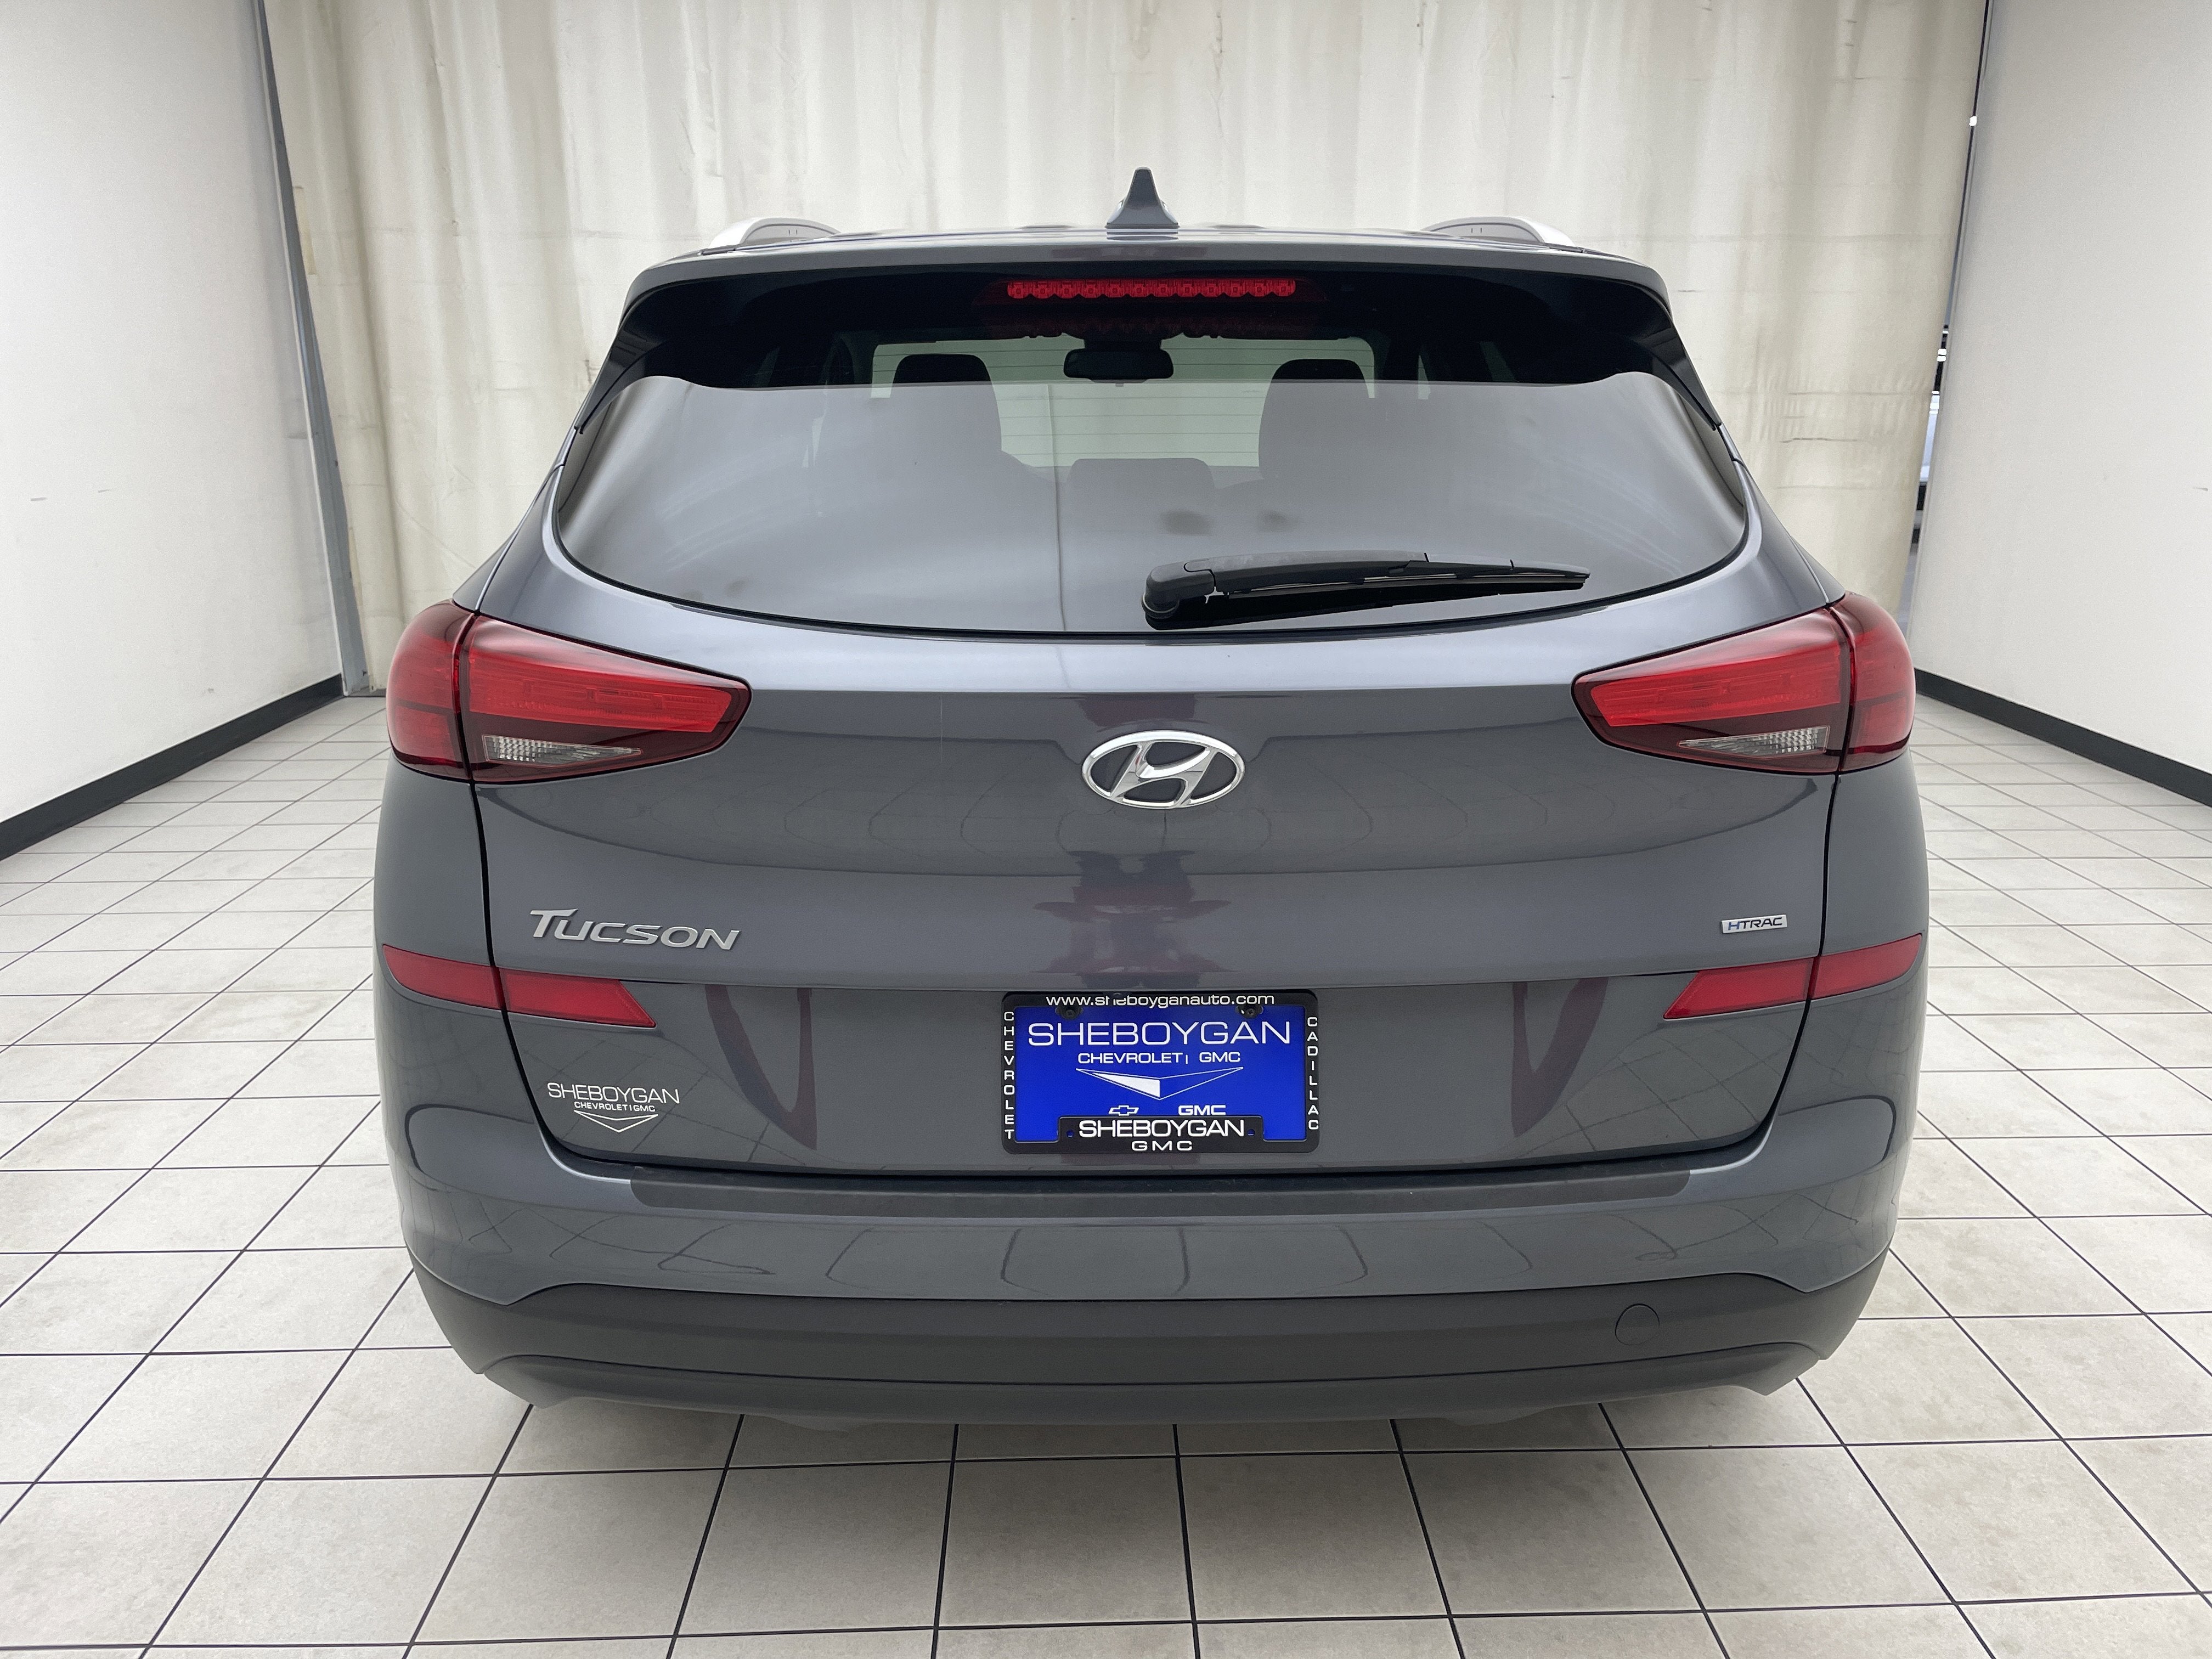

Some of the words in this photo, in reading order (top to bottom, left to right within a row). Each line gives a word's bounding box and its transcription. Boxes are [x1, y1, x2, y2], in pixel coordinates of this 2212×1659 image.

[530, 909, 741, 950] TUCSON
[1728, 917, 1782, 931] HTRAC
[1028, 1021, 1290, 1046] SHEBOYGAN
[1077, 1053, 1183, 1064] CHEVROLET
[1199, 1051, 1241, 1063] GMC
[1003, 1011, 1015, 1140] CHEVROLET
[1307, 1017, 1319, 1131] CADILLAC
[547, 1082, 680, 1104] SHEBOYGAN
[574, 1101, 628, 1111] CHEVROLET
[634, 1104, 656, 1113] GMC
[1177, 1104, 1227, 1116] GMC
[1079, 1119, 1245, 1138] SHEBOYGAN
[1131, 1140, 1193, 1152] GMC
